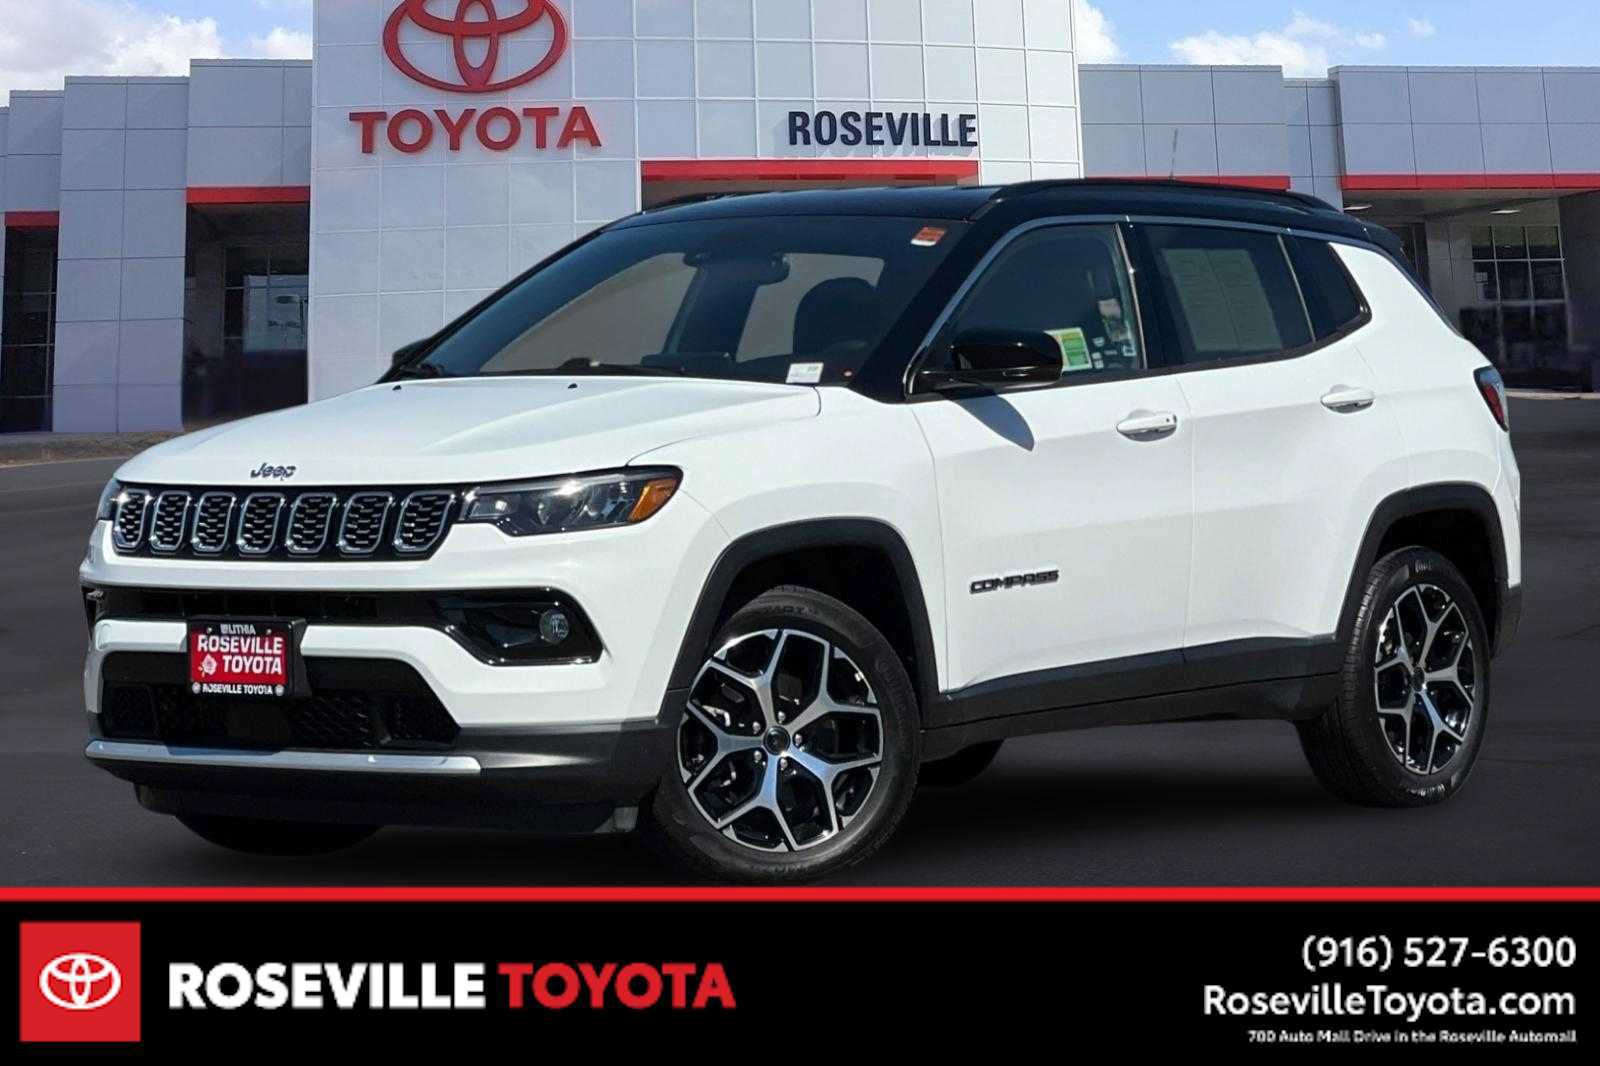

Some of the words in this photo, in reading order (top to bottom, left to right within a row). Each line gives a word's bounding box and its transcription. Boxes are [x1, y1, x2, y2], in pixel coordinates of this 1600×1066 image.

[349, 106, 602, 153] TOYOTA
[788, 111, 978, 147] ROSEVILLE
[252, 463, 296, 481] Jeep
[970, 570, 1060, 594] COMPASS
[197, 635, 284, 654] ROSEVILLE
[222, 655, 282, 675] TOYOTA
[202, 684, 242, 694] ROSEVILLE
[243, 685, 273, 695] TOYOTA
